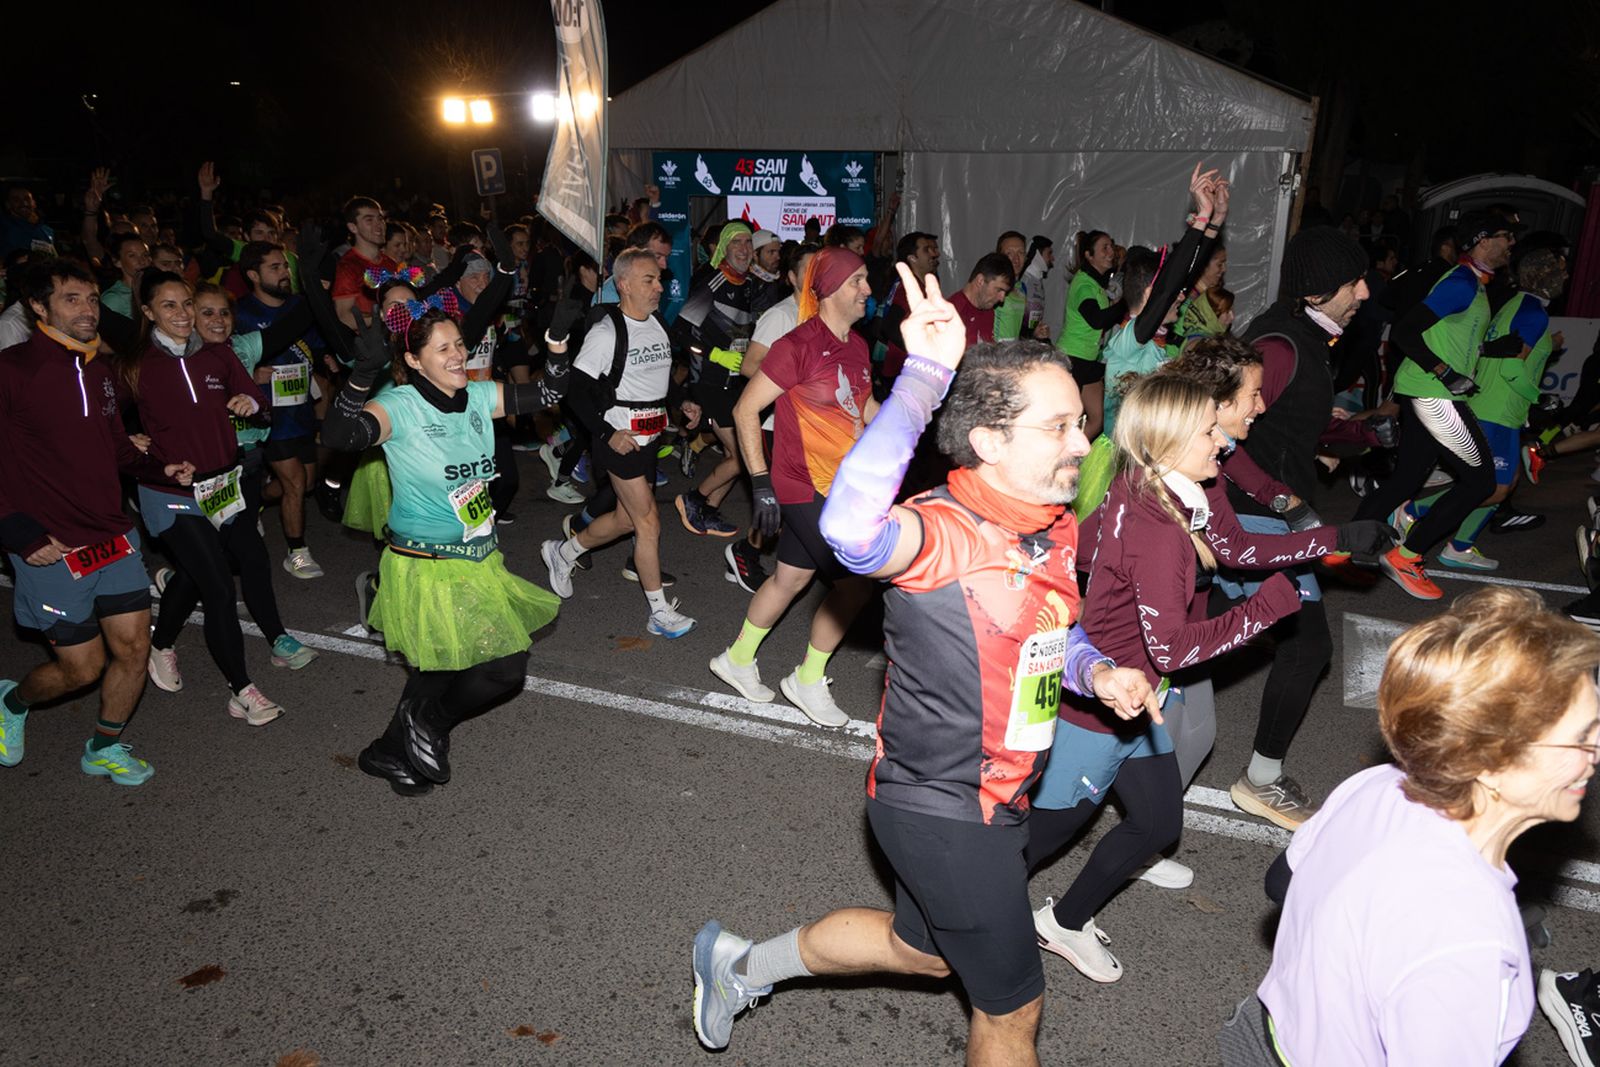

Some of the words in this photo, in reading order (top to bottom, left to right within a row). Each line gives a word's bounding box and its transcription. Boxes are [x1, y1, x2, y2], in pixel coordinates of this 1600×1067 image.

[479, 155, 497, 189] P
[735, 158, 754, 176] 43
[754, 158, 788, 174] SAN
[730, 172, 786, 192] ANTÓN
[782, 213, 807, 225] SAN
[281, 378, 305, 392] 1004
[77, 539, 121, 568] 9732
[1238, 546, 1260, 566] la
[1269, 538, 1334, 563] meta
[1039, 643, 1059, 658] NOCHE
[1179, 649, 1201, 668] la
[1027, 660, 1046, 674] SAN
[1570, 1002, 1593, 1038] HOKA
